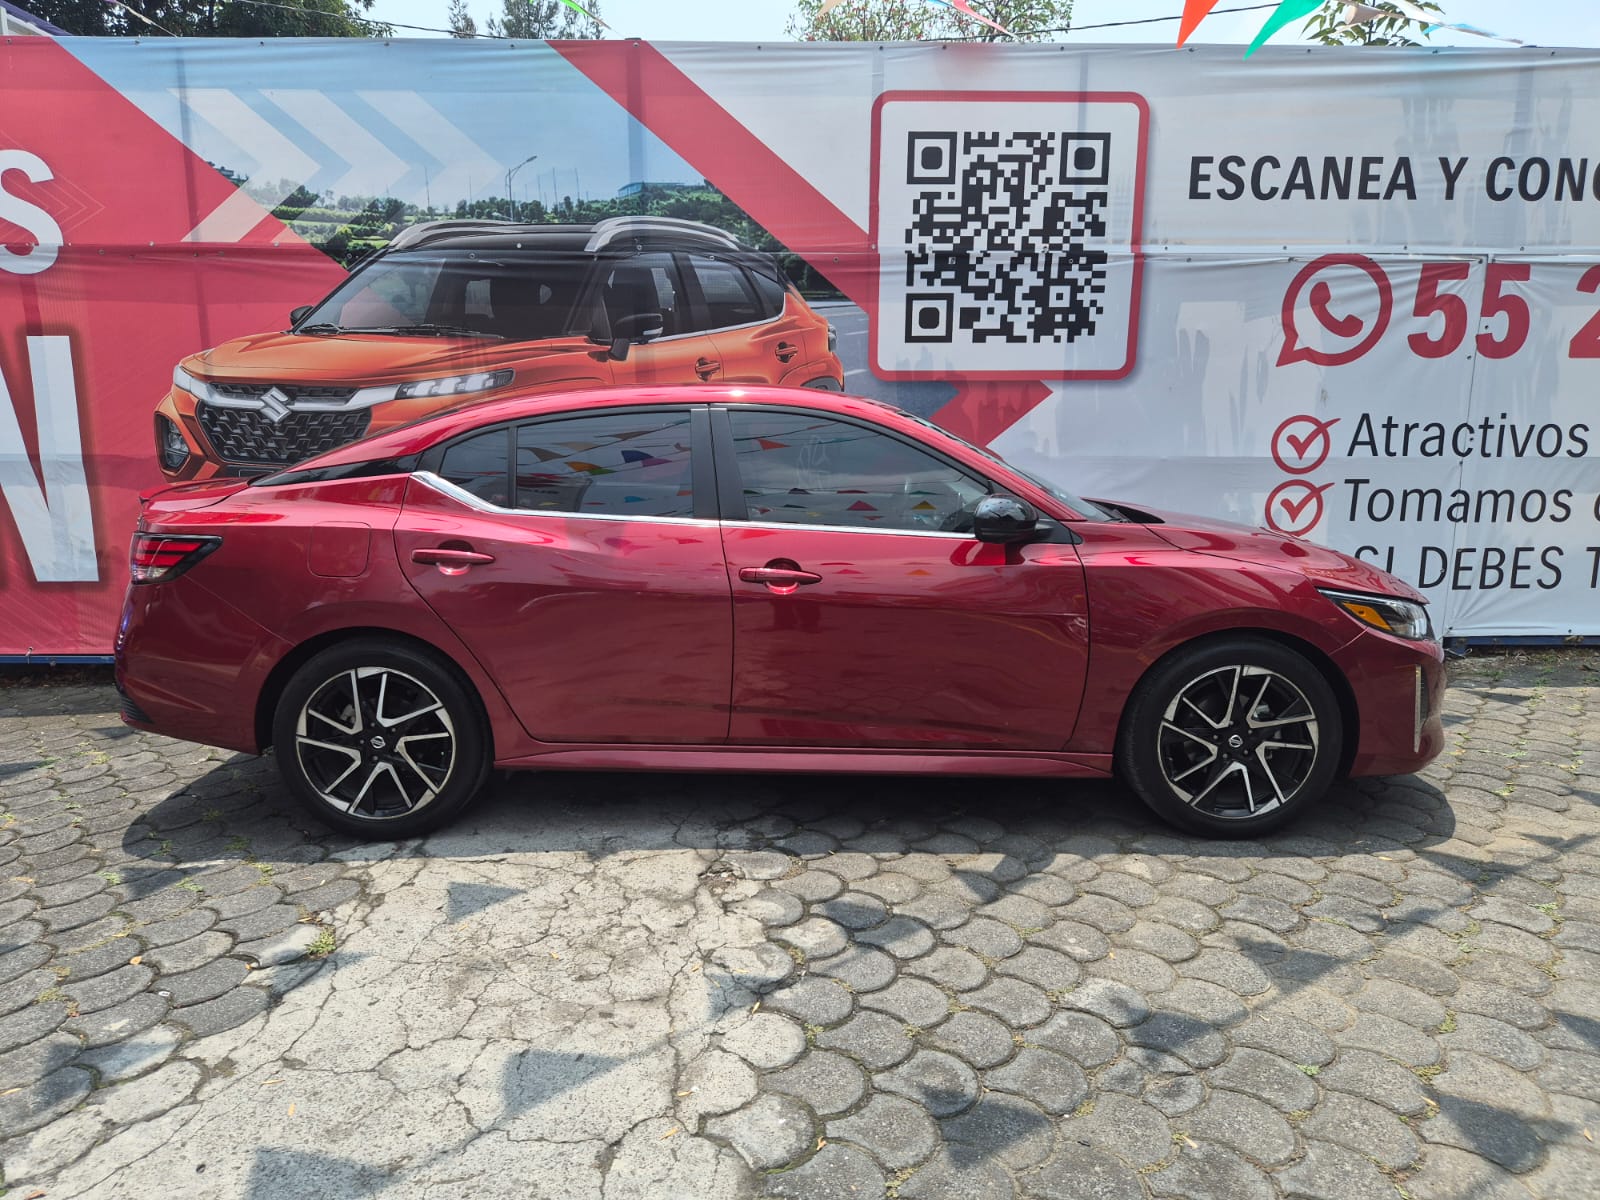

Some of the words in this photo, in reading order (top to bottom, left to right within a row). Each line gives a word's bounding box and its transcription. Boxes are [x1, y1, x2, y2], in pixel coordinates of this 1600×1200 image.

[1188, 155, 1417, 201] ESCANEA
[1438, 157, 1469, 200] Y
[1485, 156, 1600, 202] CON
[0, 149, 64, 275] S
[1407, 263, 1531, 360] 55
[1346, 412, 1590, 458] Atractivos
[1344, 478, 1573, 523] Tomamos
[1418, 546, 1564, 590] DEBES
